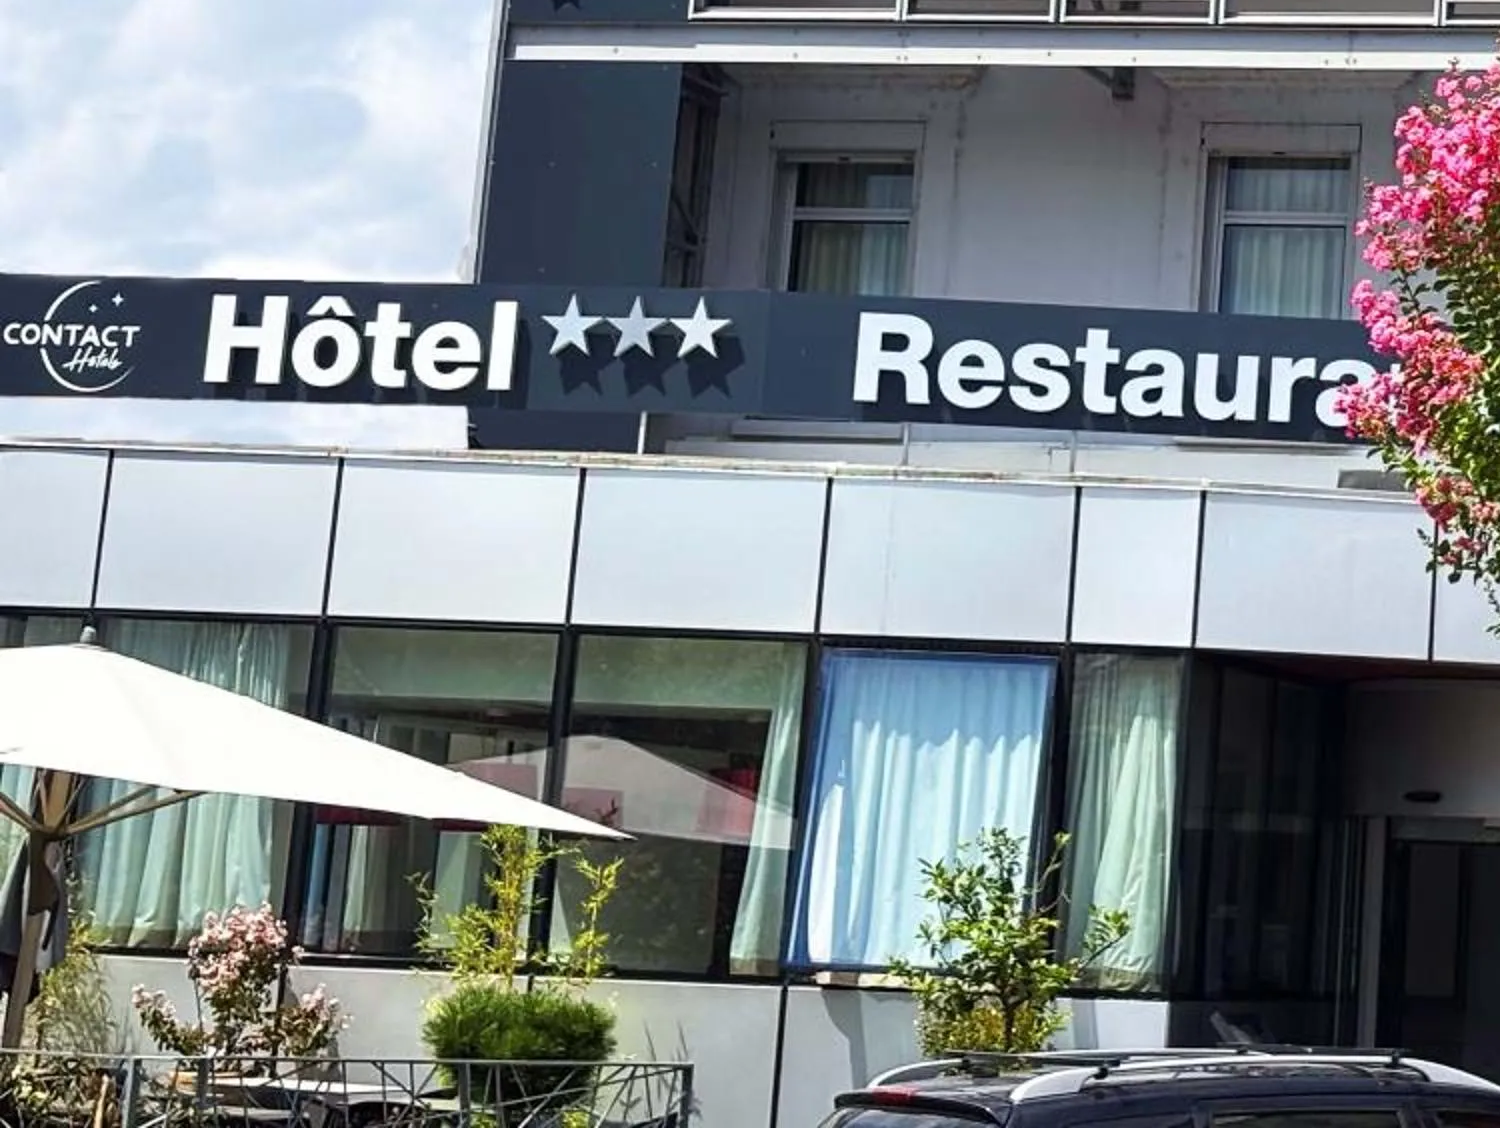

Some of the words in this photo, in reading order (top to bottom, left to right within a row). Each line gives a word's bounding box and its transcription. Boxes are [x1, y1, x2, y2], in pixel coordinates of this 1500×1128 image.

[3, 322, 141, 348] CONTACT
[203, 294, 518, 390] Hôtel
[853, 312, 1405, 429] Restaura
